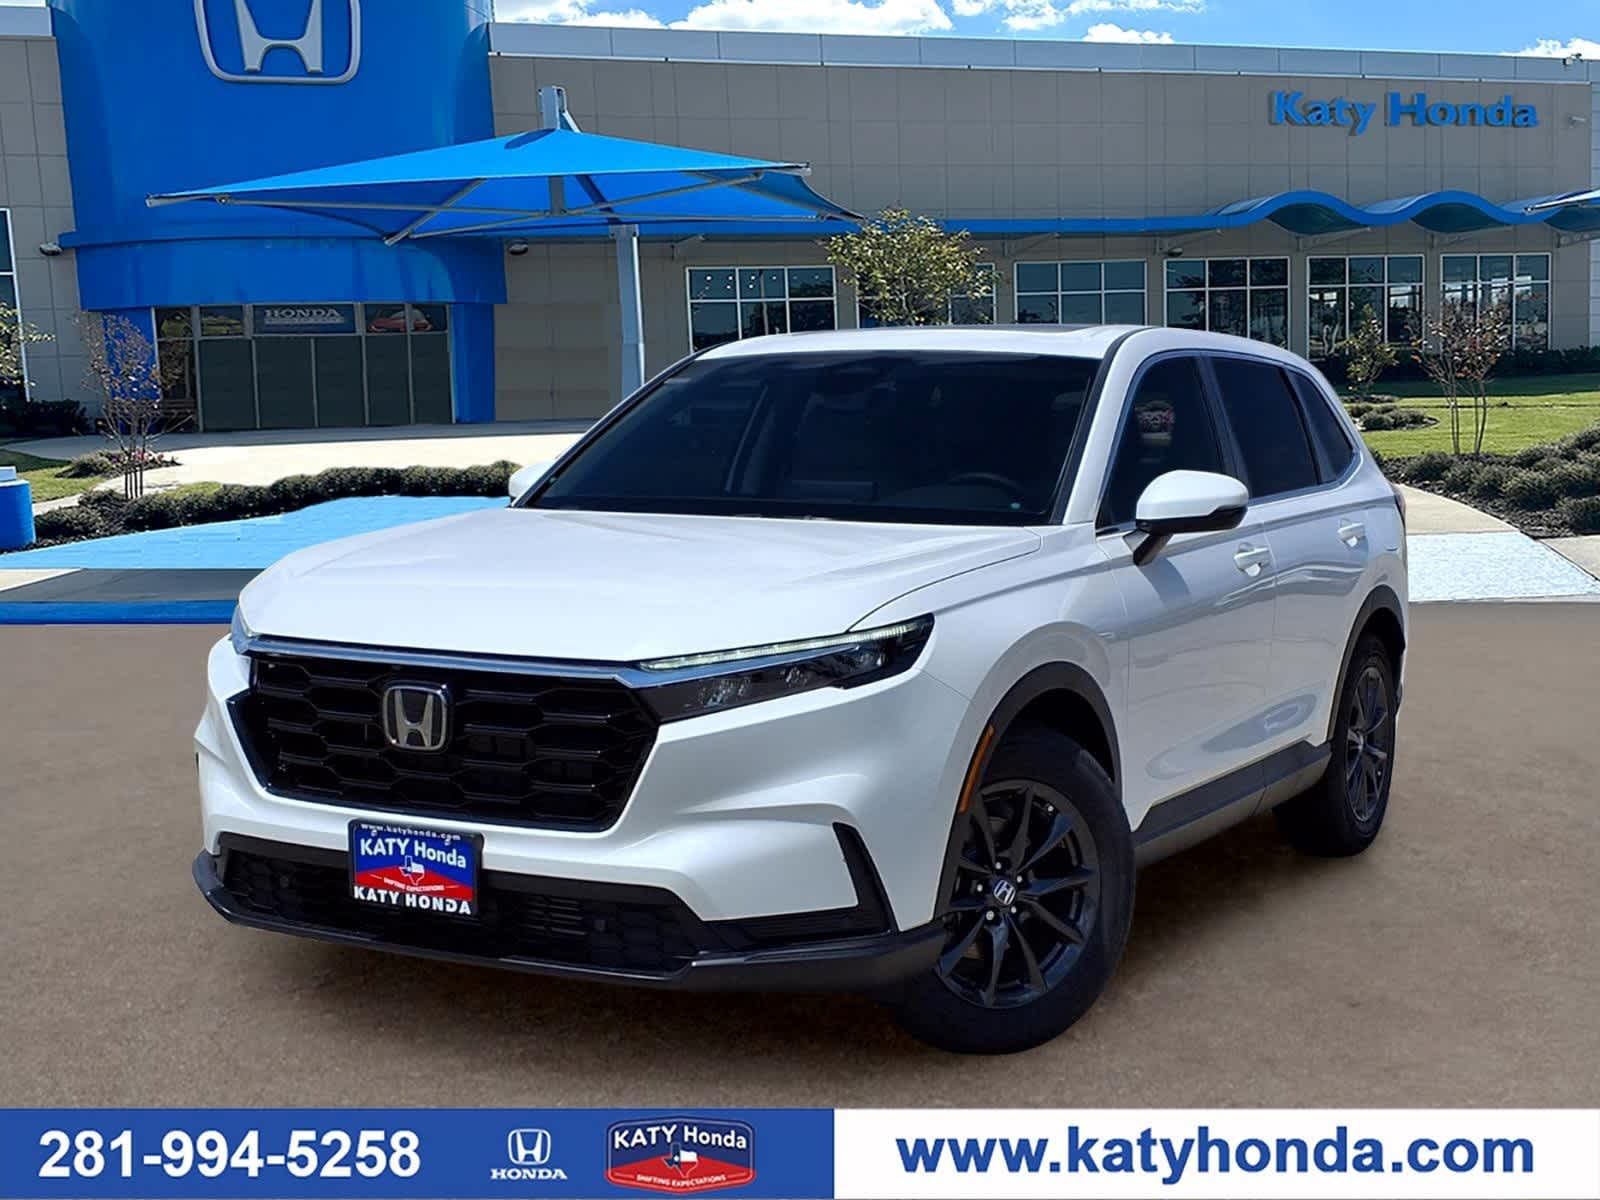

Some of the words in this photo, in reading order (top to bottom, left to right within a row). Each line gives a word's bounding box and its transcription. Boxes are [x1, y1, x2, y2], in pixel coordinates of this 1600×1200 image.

[1269, 90, 1376, 136] Katy
[1385, 91, 1539, 127] Honda
[264, 308, 341, 318] HONDA
[360, 823, 461, 841] www.katyhonda.com
[360, 838, 410, 856] KATY
[414, 840, 466, 869] Honda
[353, 885, 400, 905] KATY
[405, 893, 472, 915] HONDA
